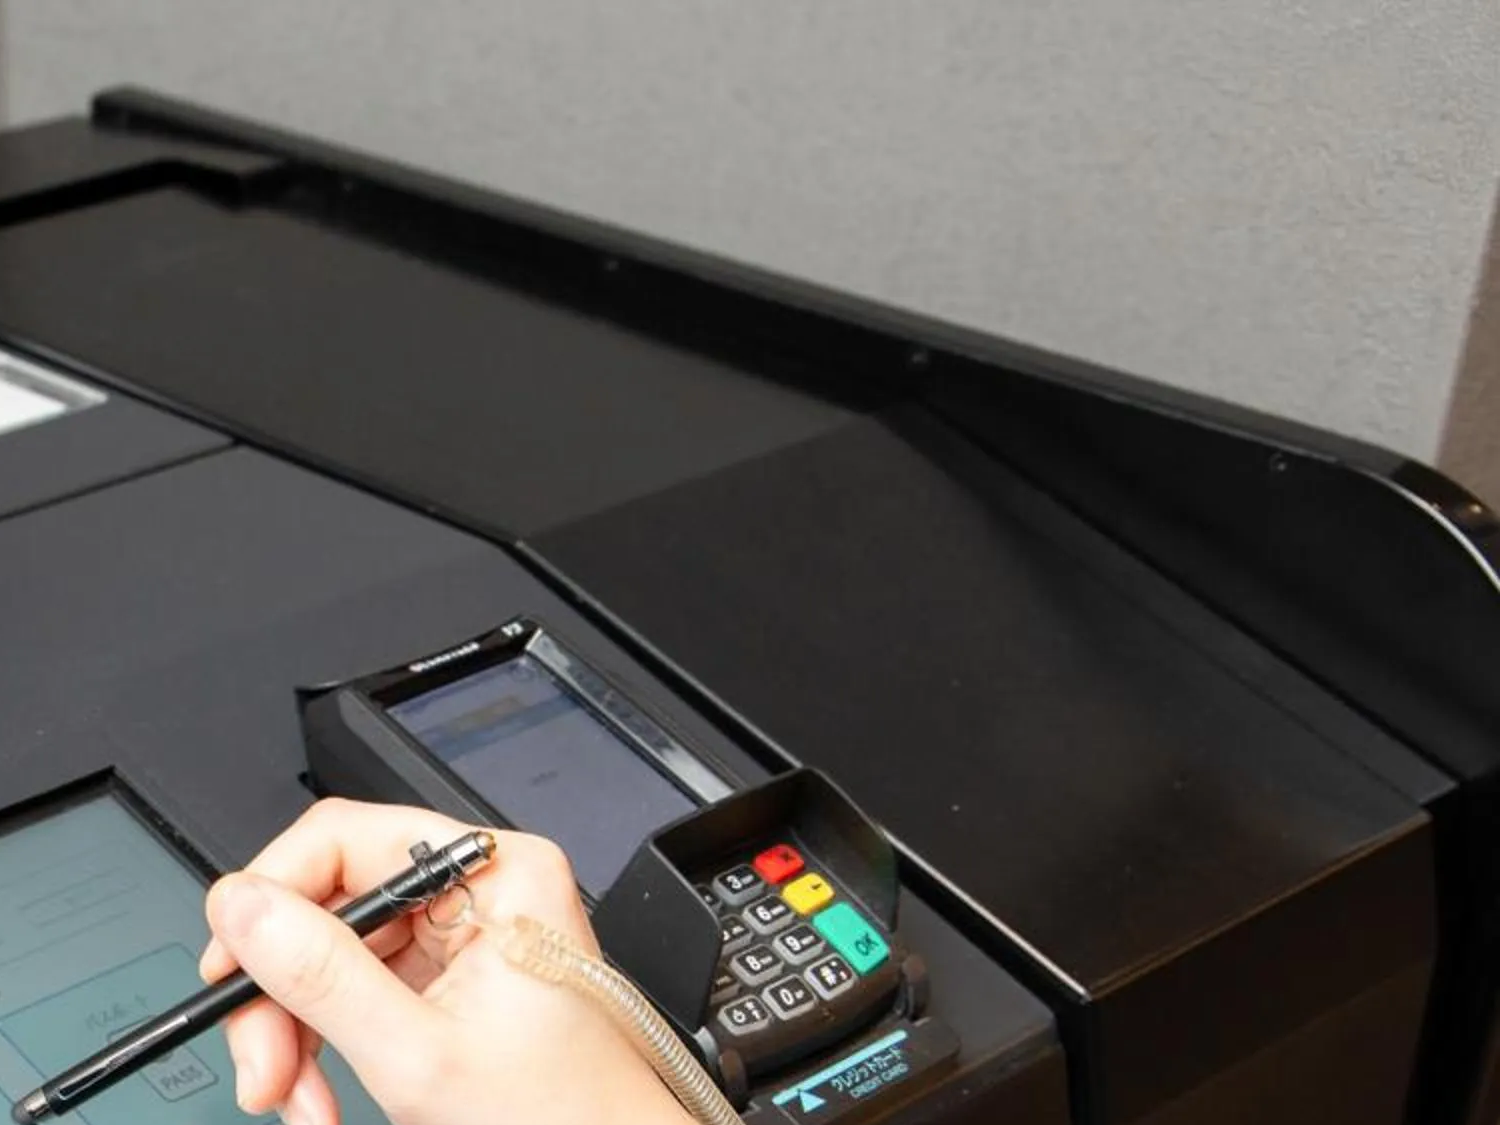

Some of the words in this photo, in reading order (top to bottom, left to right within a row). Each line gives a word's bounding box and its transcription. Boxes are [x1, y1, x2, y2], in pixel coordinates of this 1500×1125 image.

[755, 905, 772, 921] 6
[785, 935, 802, 952] 9
[854, 932, 880, 957] OK
[745, 954, 762, 972] 8
[779, 988, 795, 1006] 0
